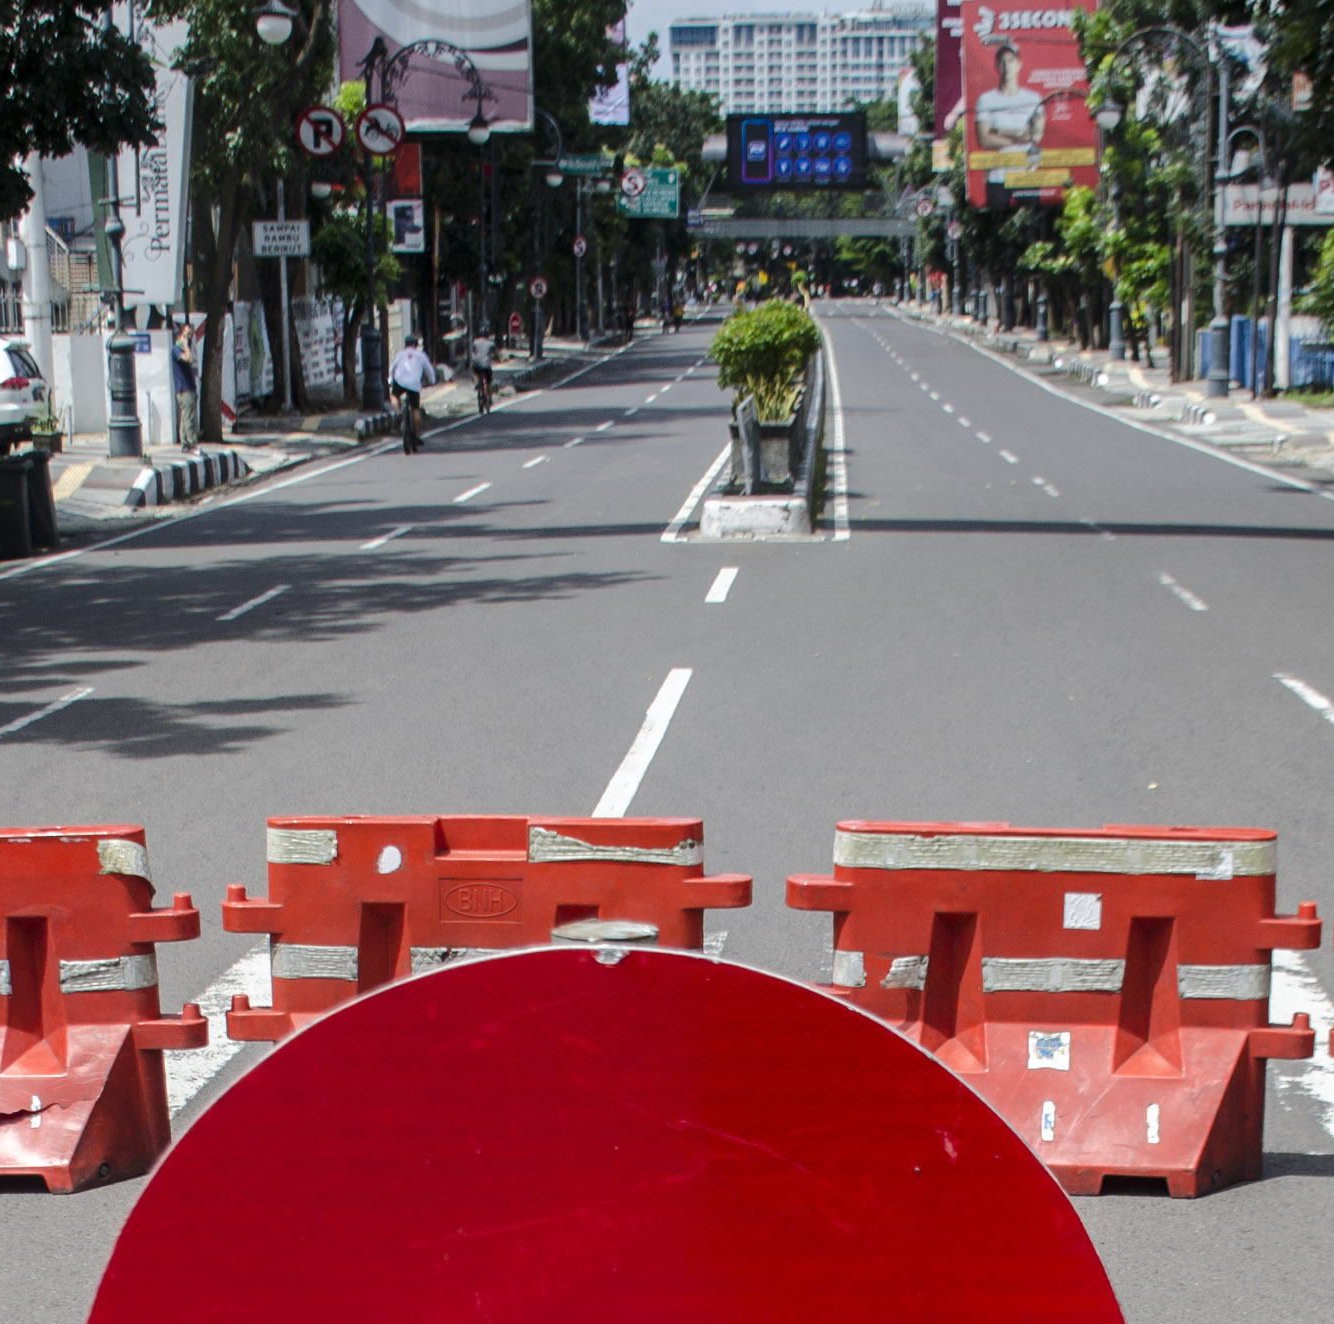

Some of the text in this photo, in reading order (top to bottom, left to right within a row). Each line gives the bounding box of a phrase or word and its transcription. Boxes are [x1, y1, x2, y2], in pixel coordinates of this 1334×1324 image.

[998, 9, 1073, 30] 3SECON
[263, 224, 300, 234] SAMPAI
[264, 234, 300, 244] RAMBU
[261, 244, 302, 254] BERIKUT
[458, 887, 504, 912] BNH
